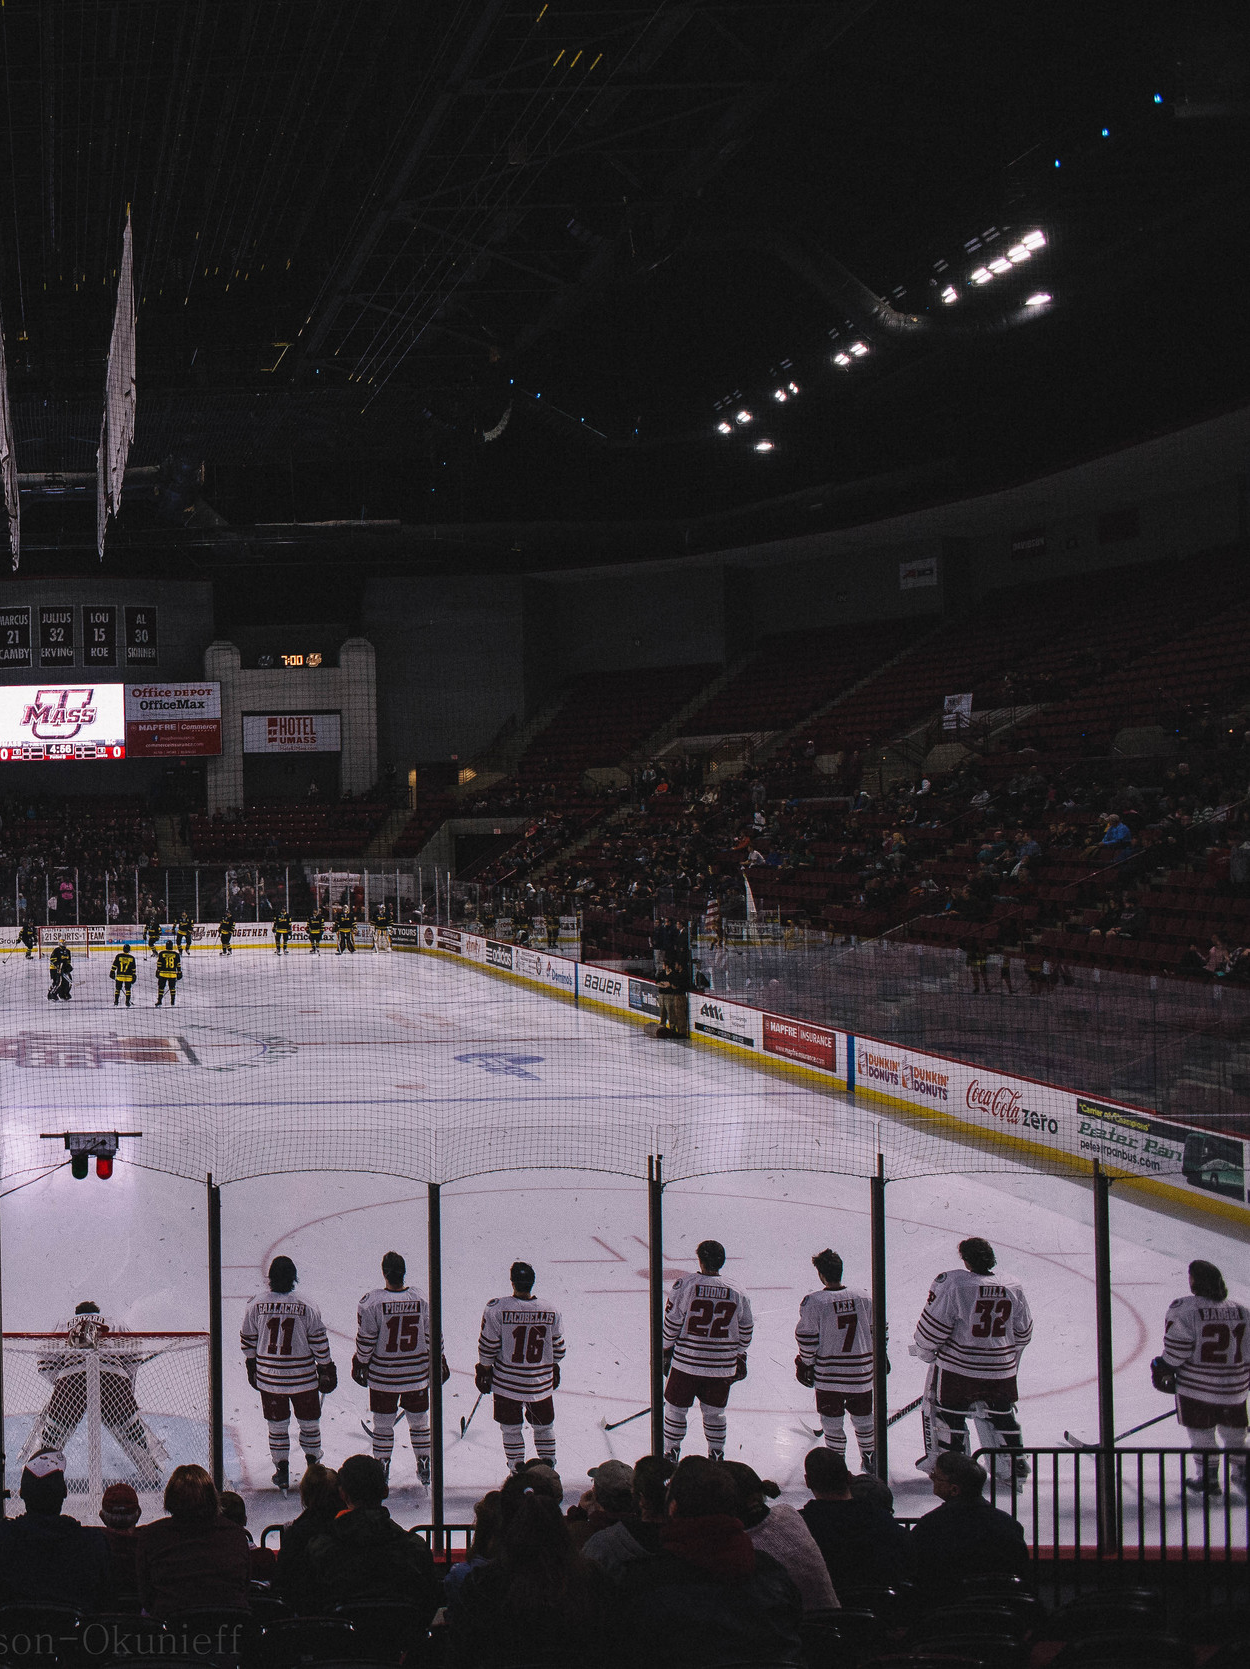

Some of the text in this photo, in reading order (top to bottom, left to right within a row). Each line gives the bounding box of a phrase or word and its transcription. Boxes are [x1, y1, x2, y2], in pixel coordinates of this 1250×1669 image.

[42, 612, 71, 624] JULIUS
[90, 613, 109, 622] LOU
[136, 614, 147, 624] AL
[7, 631, 20, 644] 21
[49, 628, 64, 641] 32
[94, 628, 107, 641] 15
[135, 629, 149, 643] 30
[280, 654, 304, 666] 7:00
[132, 687, 213, 698] Office DEPOT
[140, 699, 205, 710] OfficeMax
[138, 723, 177, 731] MAPFRE
[180, 723, 217, 731] Commerce
[279, 717, 316, 736] HOTEL
[279, 736, 317, 744] UMASS
[0, 748, 9, 760] 0
[49, 744, 72, 754] 4:56
[113, 746, 121, 757] 0
[584, 973, 622, 997] BAUER
[770, 1021, 832, 1048] MAPFRE INSURANCE
[868, 1053, 900, 1073] DUNKIN'
[868, 1067, 899, 1086] DONUTS
[913, 1066, 949, 1087] DUNKIN'
[914, 1082, 948, 1101] DONUTS
[1021, 1108, 1059, 1135] zero
[1143, 1138, 1183, 1162] Pan
[698, 1286, 729, 1299] BUONO
[982, 1286, 1005, 1297] DILL
[385, 1302, 418, 1313] PIGOZZI
[835, 1300, 854, 1313] LEE
[503, 1311, 554, 1324] IACOBELLIS
[687, 1299, 737, 1338] 22
[971, 1300, 1012, 1338] 32
[266, 1317, 294, 1356] 11
[385, 1315, 420, 1353] 15
[837, 1314, 858, 1353] 7
[511, 1325, 547, 1363] 16
[1200, 1323, 1246, 1364] 21
